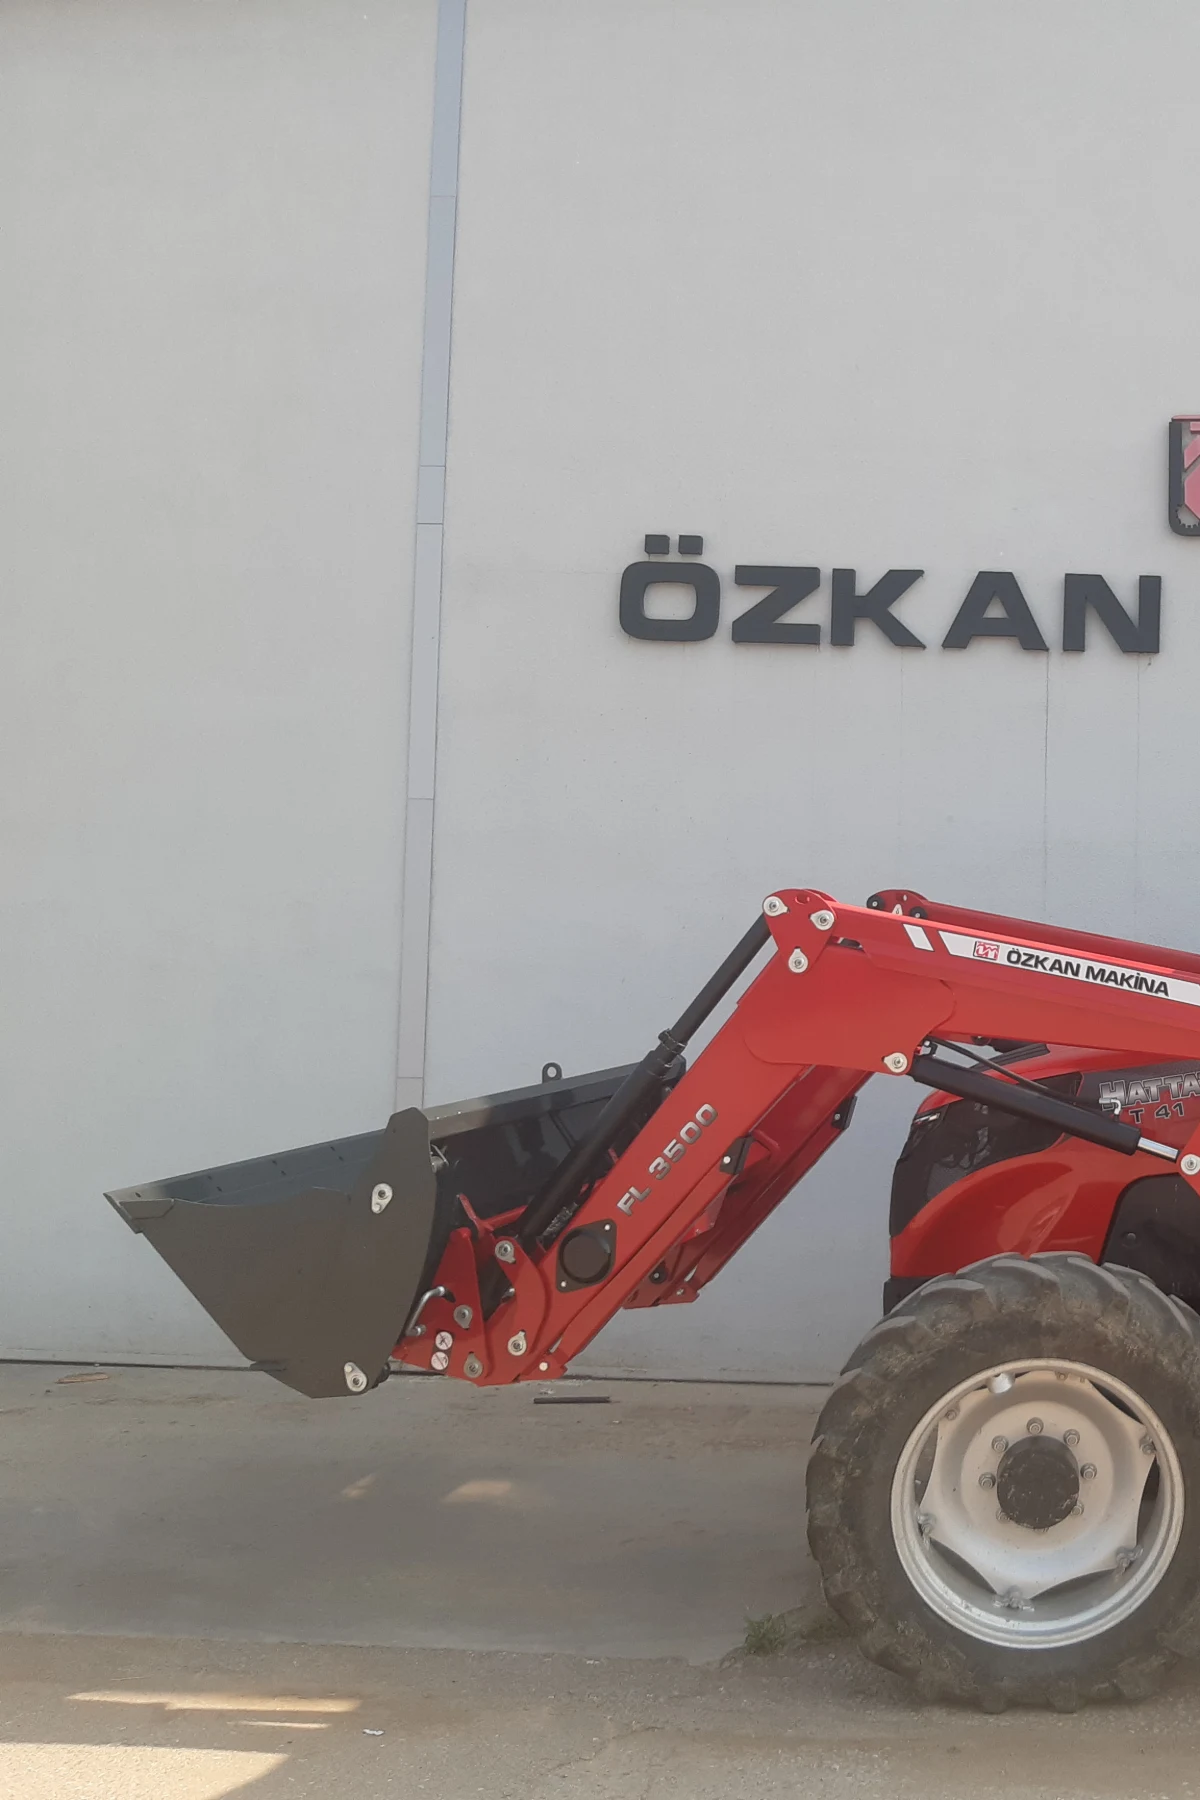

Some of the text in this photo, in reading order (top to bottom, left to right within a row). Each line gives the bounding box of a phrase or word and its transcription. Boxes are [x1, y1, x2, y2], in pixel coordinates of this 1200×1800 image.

[619, 534, 1161, 653] ÖZKAN
[1006, 947, 1169, 997] ÖZKAN MAKİNA
[616, 1103, 718, 1216] FL 3500
